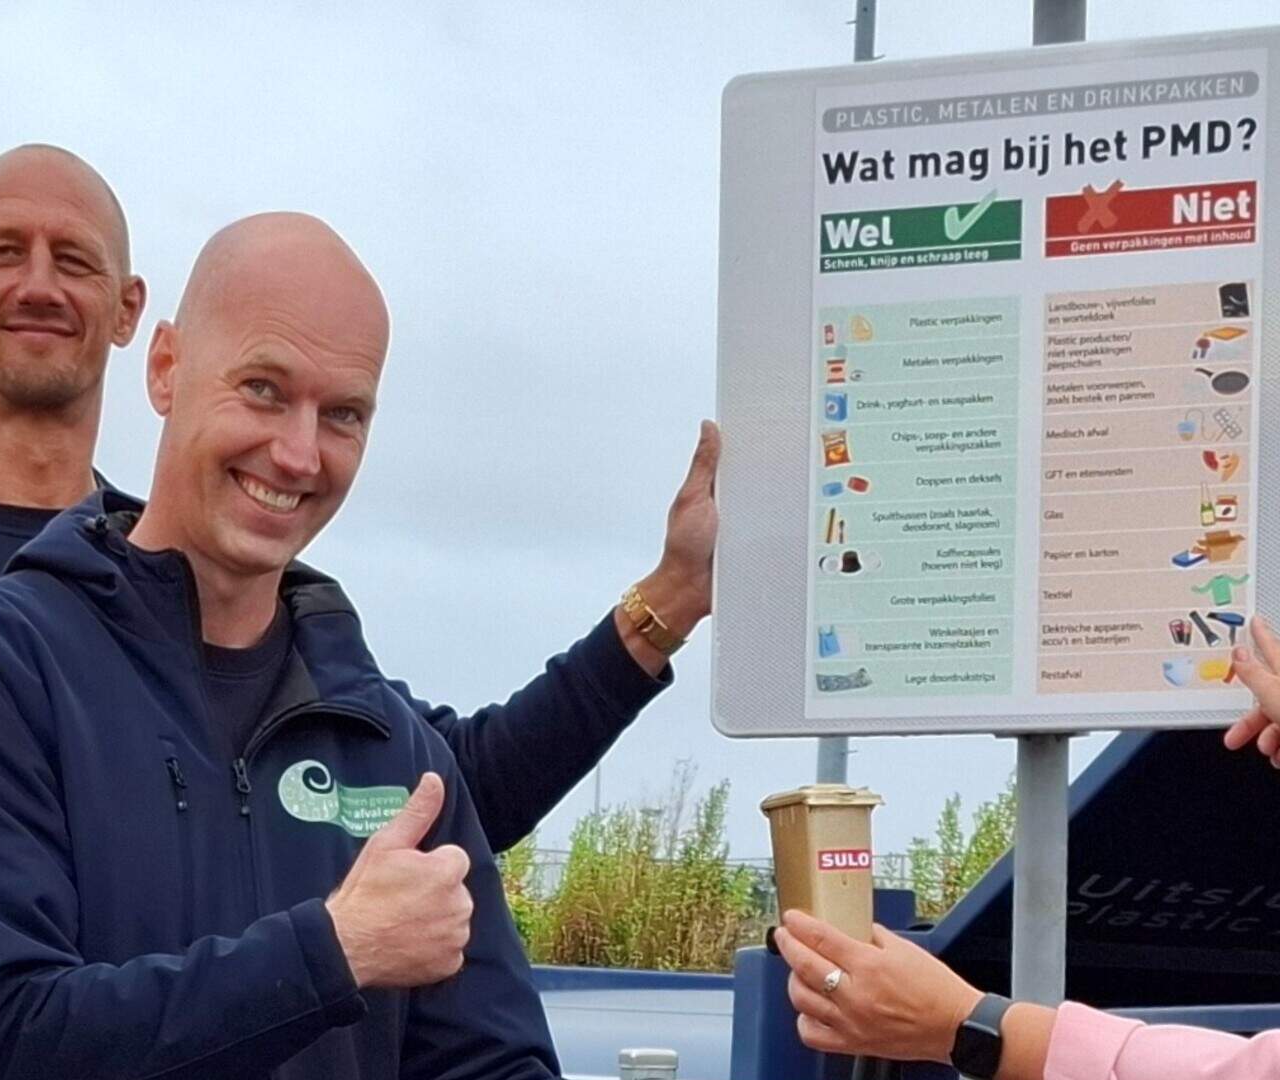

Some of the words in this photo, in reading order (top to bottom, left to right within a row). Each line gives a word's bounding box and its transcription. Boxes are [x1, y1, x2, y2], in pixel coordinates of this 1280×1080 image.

[835, 104, 931, 128] PLASTIC,
[938, 95, 1037, 120] METALEN
[1047, 92, 1075, 110] EN
[1084, 77, 1246, 107] DRINKPAKKEN
[822, 149, 894, 184] Wat
[908, 146, 989, 181] mag
[1003, 134, 1051, 176] bij
[1064, 129, 1127, 166] het
[1142, 117, 1257, 159] PMD?
[1172, 190, 1251, 225] Niet
[824, 217, 893, 249] Wel
[1070, 240, 1100, 253] Geen
[1103, 233, 1182, 252] verpakkingen
[1185, 232, 1207, 244] met
[1209, 229, 1251, 243] inhoud
[823, 255, 868, 271] Schenk,
[870, 253, 897, 270] knijp
[900, 254, 914, 265] en
[917, 249, 961, 266] schraap
[963, 248, 989, 263] leeg
[910, 316, 938, 327] Plastic
[941, 313, 1002, 327] verpakkingen
[1048, 316, 1061, 325] en
[1062, 311, 1114, 324] worteldoek
[1048, 335, 1077, 346] Plastic
[1079, 332, 1132, 346] producten/
[902, 356, 939, 368] Metalen
[942, 354, 1003, 367] verpakkingen
[1046, 383, 1084, 395] Metalen
[928, 397, 939, 406] en
[942, 394, 994, 407] sauspakken
[1046, 395, 1070, 406] zoals
[1072, 394, 1102, 404] bestek
[1105, 394, 1117, 402] en
[1119, 392, 1155, 403] pannen
[952, 430, 963, 439] en
[965, 428, 997, 438] andere
[1046, 429, 1085, 440] Medisch
[1087, 427, 1109, 438] afval
[915, 440, 1001, 453] verpakkingszakken
[916, 477, 954, 488] Doppen
[956, 476, 967, 485] en
[969, 473, 1002, 484] deksels
[1045, 470, 1063, 480] GFT
[1065, 470, 1077, 479] en
[872, 510, 928, 523] Spuitbussen
[1044, 510, 1064, 520] Glas
[936, 547, 1001, 559] Koffiecapsules
[1043, 550, 1073, 560] Papier
[1075, 549, 1087, 558] en
[1089, 548, 1119, 558] karton
[922, 560, 958, 572] (hoeven
[960, 559, 978, 569] niet
[980, 558, 1003, 571] leeg)
[890, 596, 915, 606] Grote
[918, 593, 996, 606] verpakkingsfolies
[1042, 590, 1072, 600] Textiel
[929, 627, 986, 639] Winkeltasjes
[987, 627, 999, 636] en
[1042, 623, 1092, 635] Elektrische
[1071, 636, 1083, 645] en
[1085, 634, 1130, 646] batterijen
[865, 641, 922, 653] transparante
[905, 675, 928, 686] Lege
[929, 672, 996, 684] doordrukstrips
[1041, 669, 1082, 680] Restafval
[353, 808, 382, 819] afval
[821, 853, 870, 867] SULO
